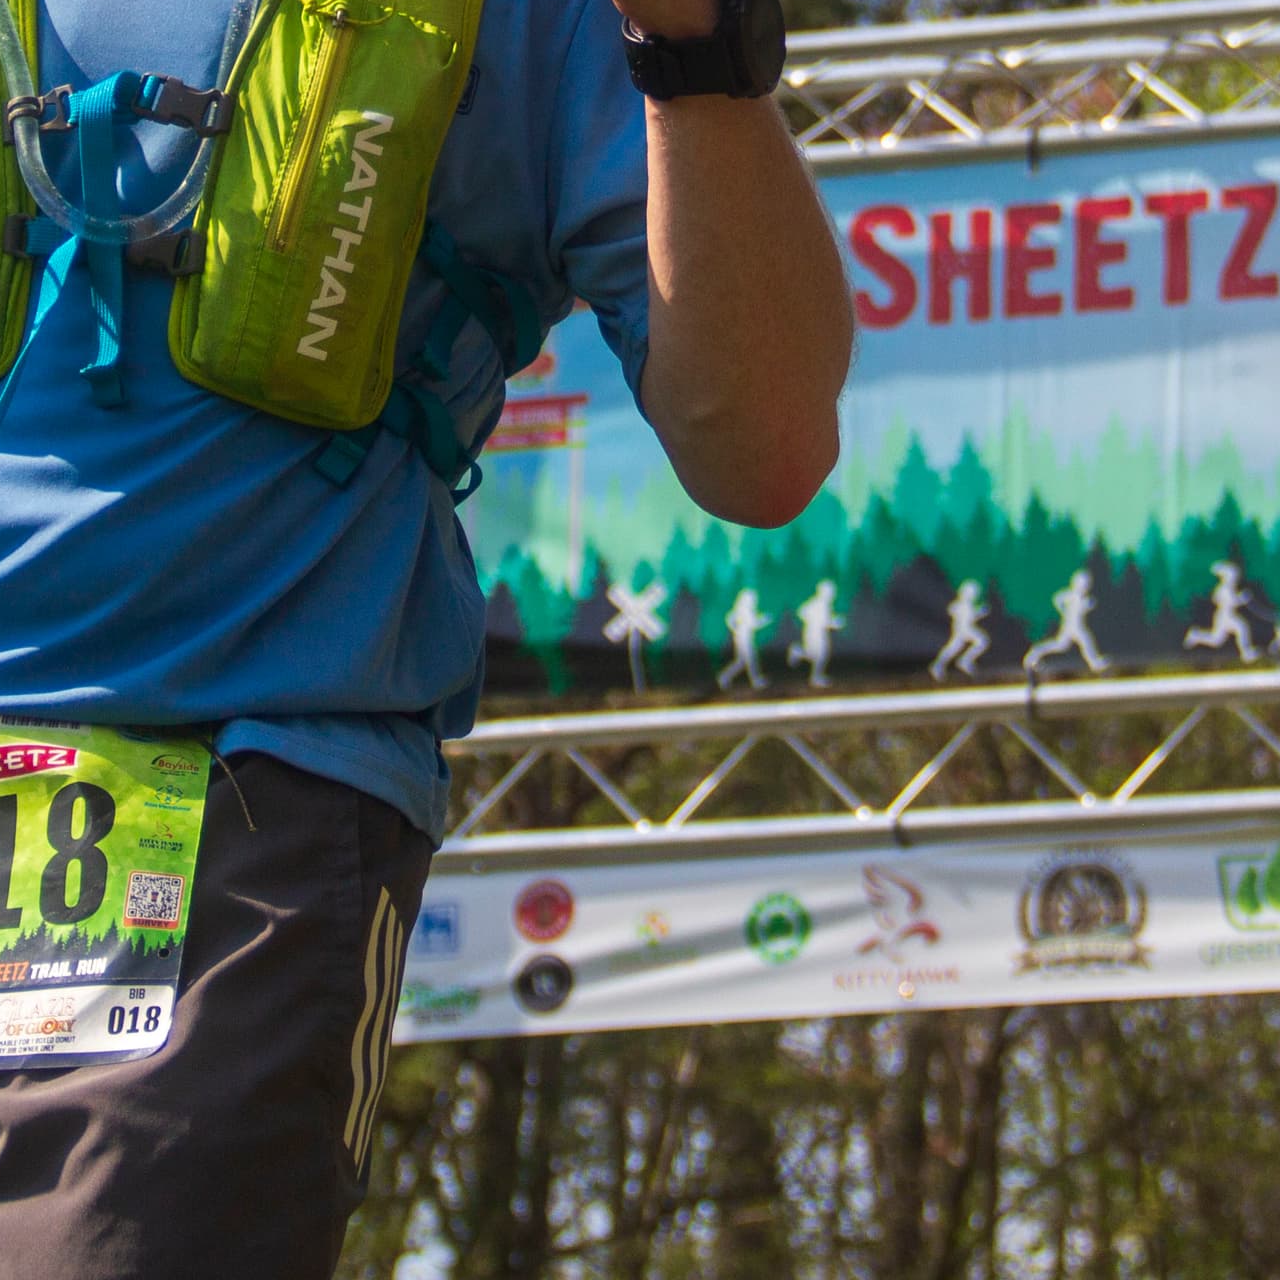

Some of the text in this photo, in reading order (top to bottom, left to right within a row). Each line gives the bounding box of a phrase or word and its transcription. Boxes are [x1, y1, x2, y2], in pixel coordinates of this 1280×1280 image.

[296, 110, 394, 362] NATHAN
[31, 960, 72, 980] TRAIL
[75, 957, 108, 976] RUN
[129, 988, 146, 1000] BIB
[6, 1018, 76, 1037] OF GLORY
[108, 1006, 162, 1035] 018
